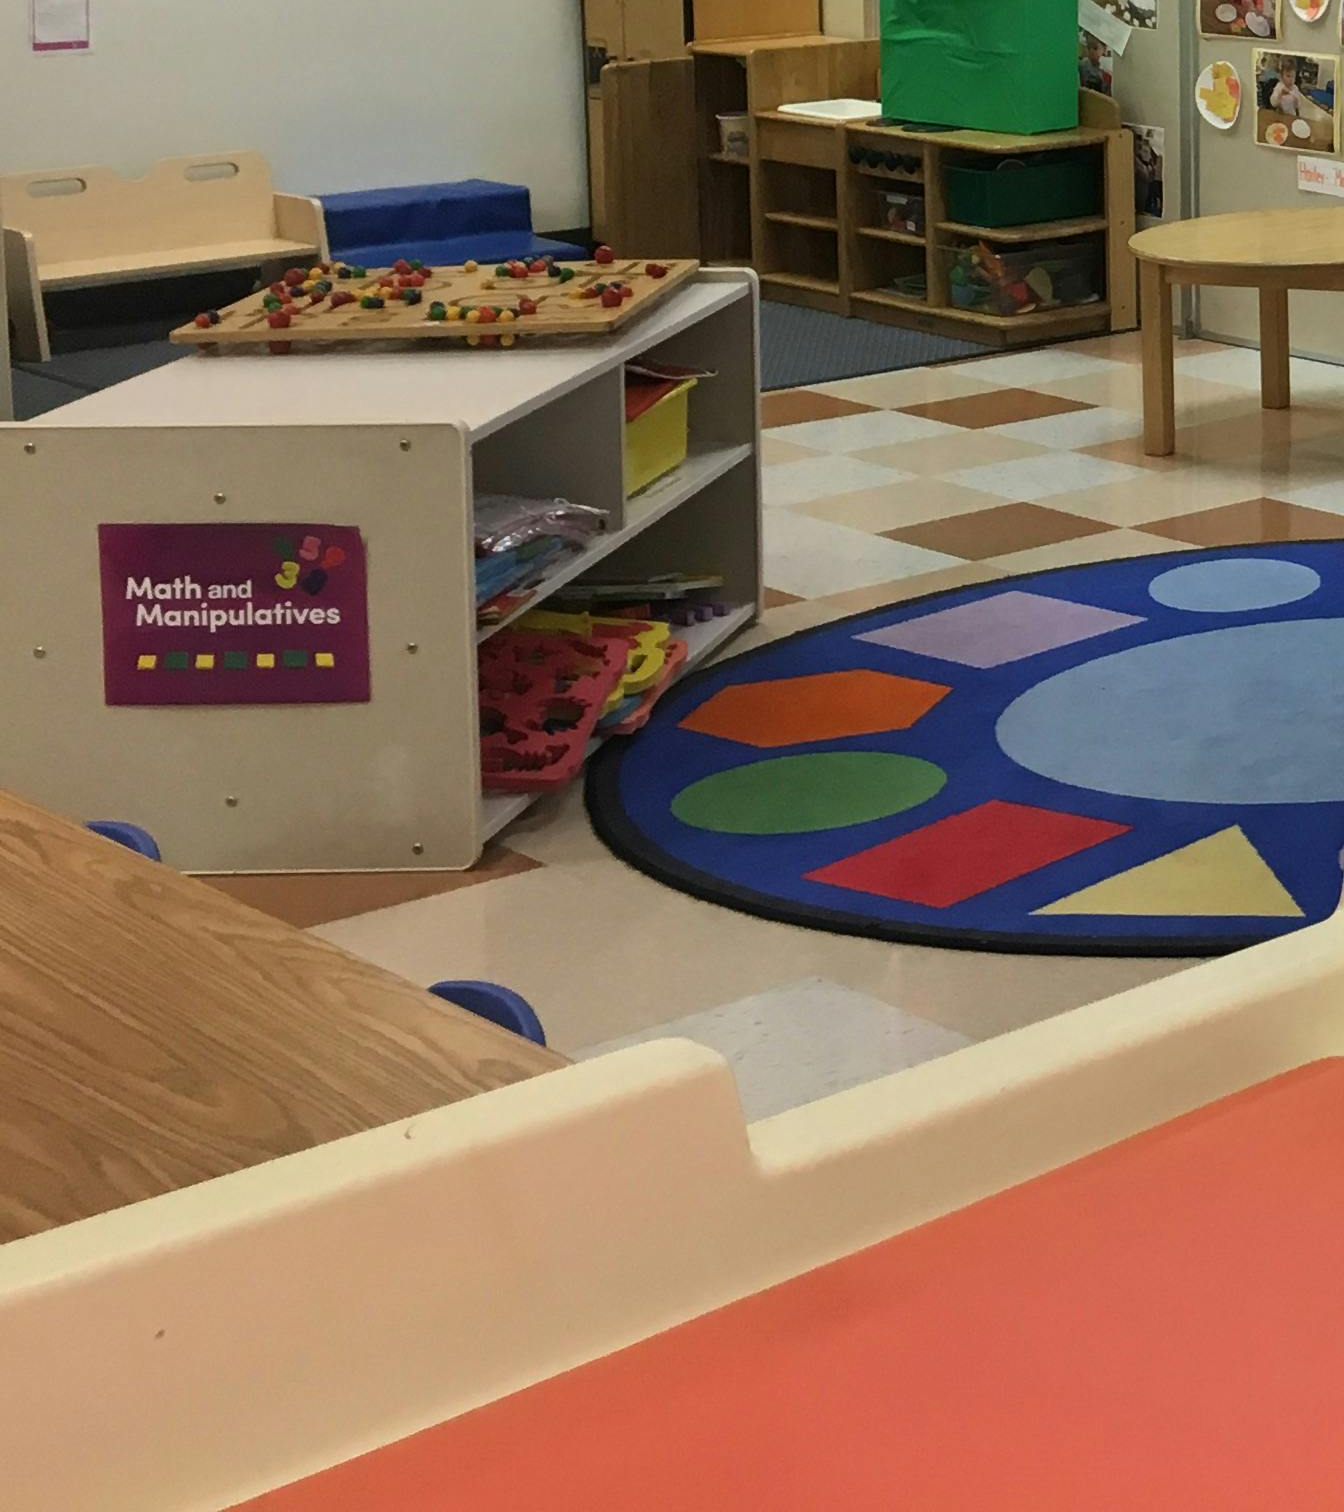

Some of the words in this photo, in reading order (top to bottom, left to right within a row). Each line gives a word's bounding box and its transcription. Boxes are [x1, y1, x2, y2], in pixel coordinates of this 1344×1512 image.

[126, 575, 202, 600] Math
[207, 580, 252, 599] and
[136, 601, 341, 633] Manipulatives
